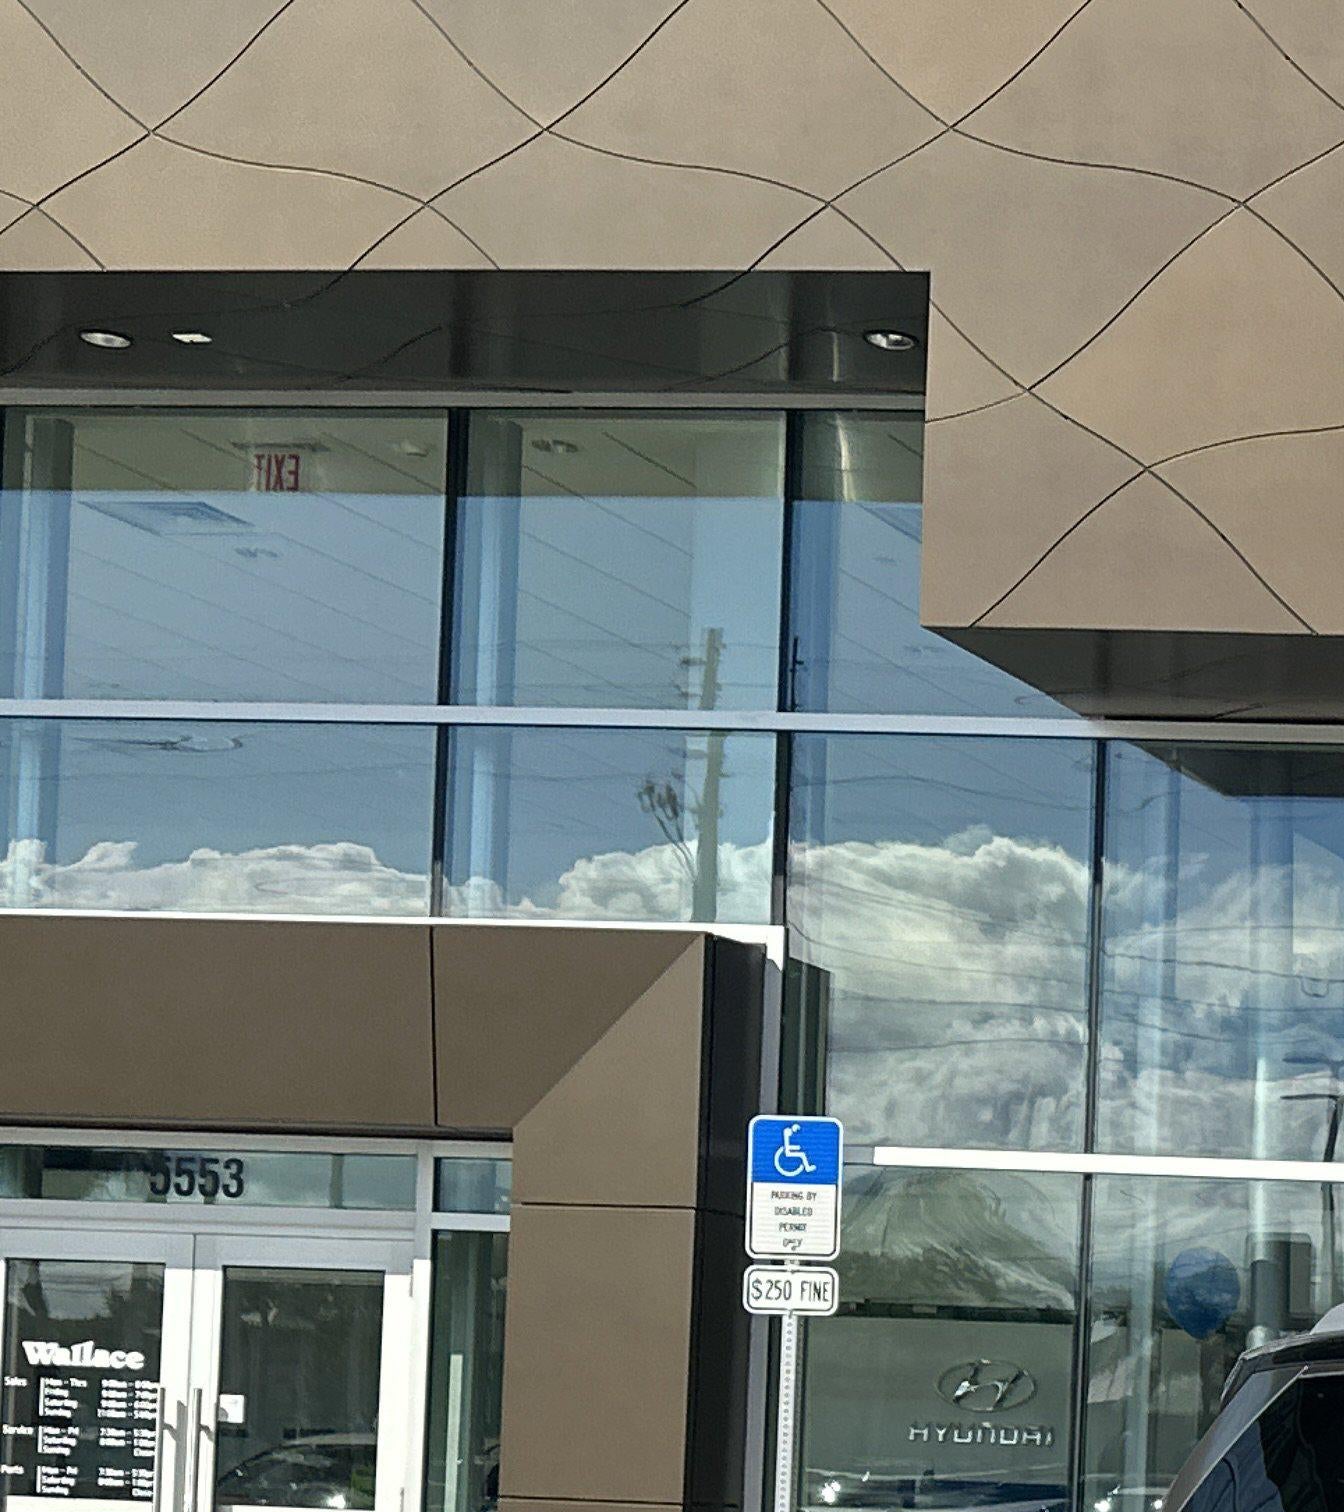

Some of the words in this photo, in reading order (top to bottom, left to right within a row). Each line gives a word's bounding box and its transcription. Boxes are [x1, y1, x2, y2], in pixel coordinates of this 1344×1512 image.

[150, 1156, 245, 1198] 5553
[751, 1278, 792, 1301] $250
[800, 1280, 830, 1302] FINE
[21, 1340, 146, 1370] Wallace
[909, 1420, 1056, 1446] HYUNDAI
